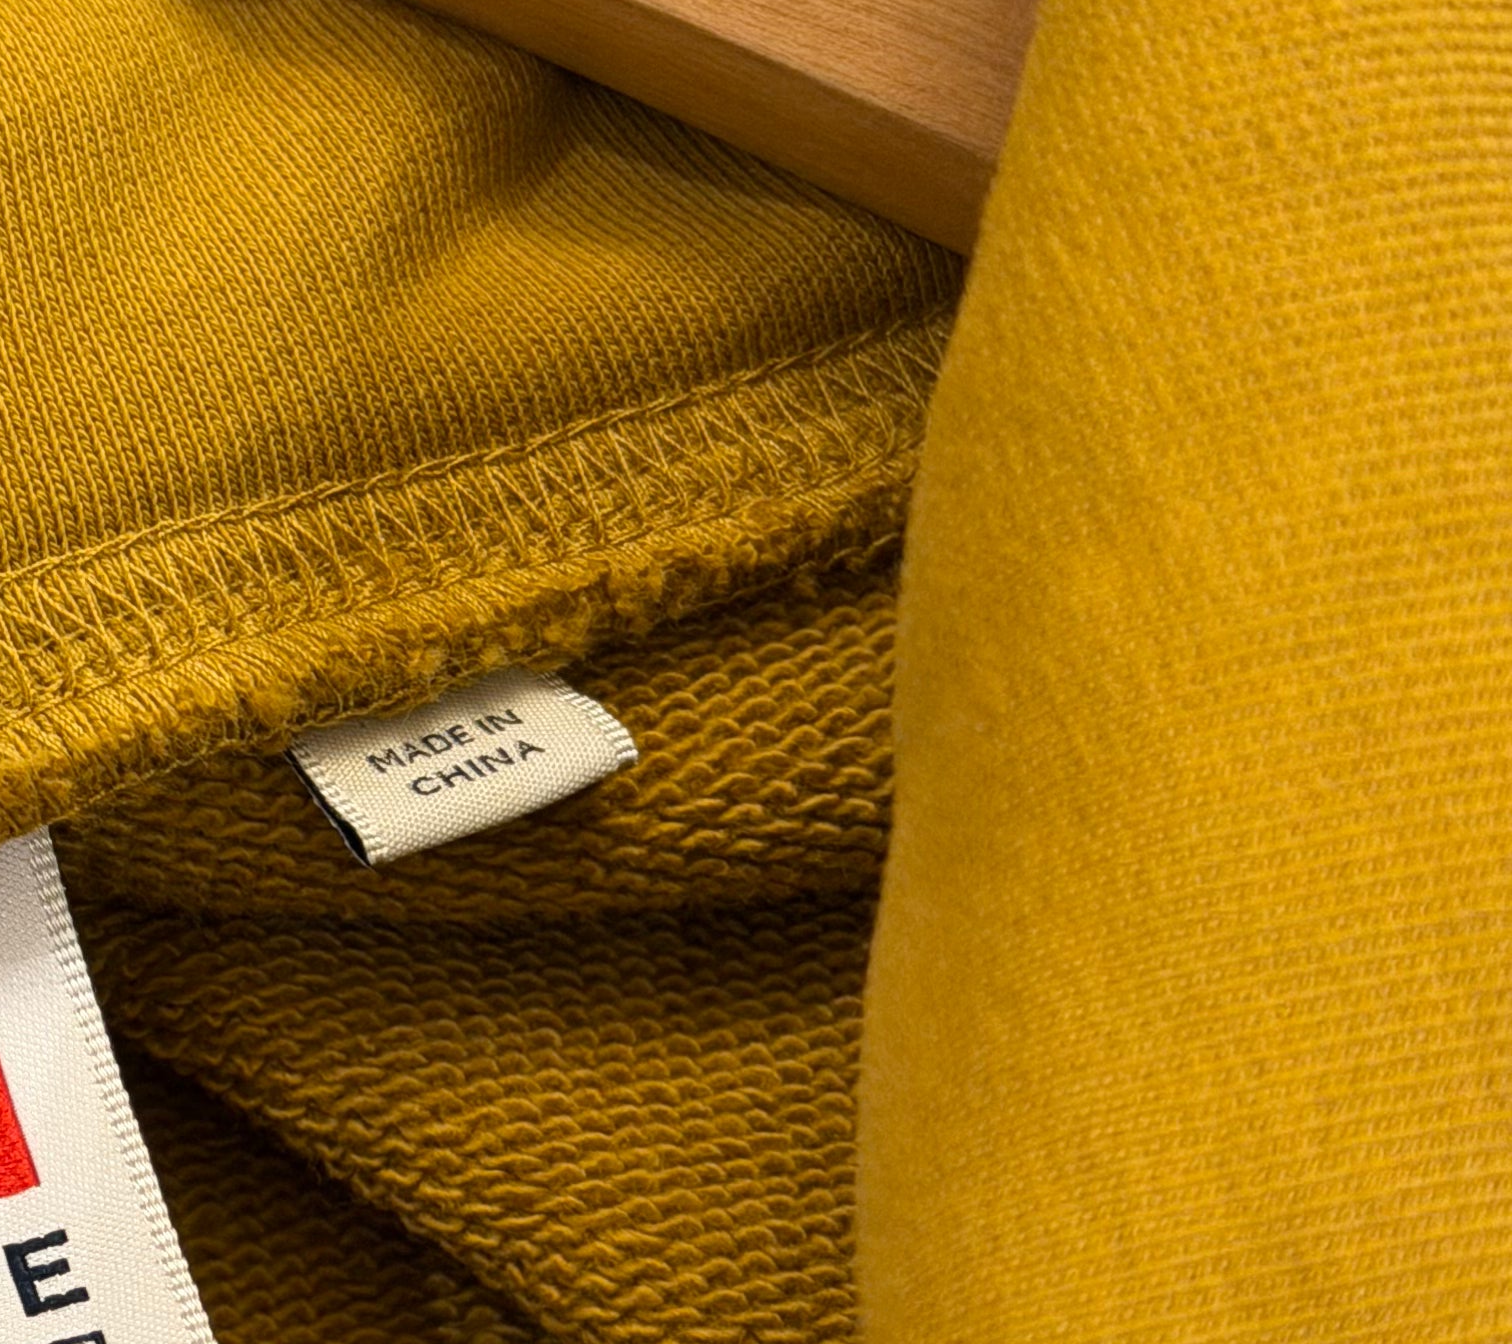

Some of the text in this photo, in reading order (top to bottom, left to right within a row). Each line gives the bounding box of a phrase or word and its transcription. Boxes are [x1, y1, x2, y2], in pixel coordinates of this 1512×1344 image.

[365, 708, 524, 775] MADE IN
[410, 739, 546, 797] CHINA
